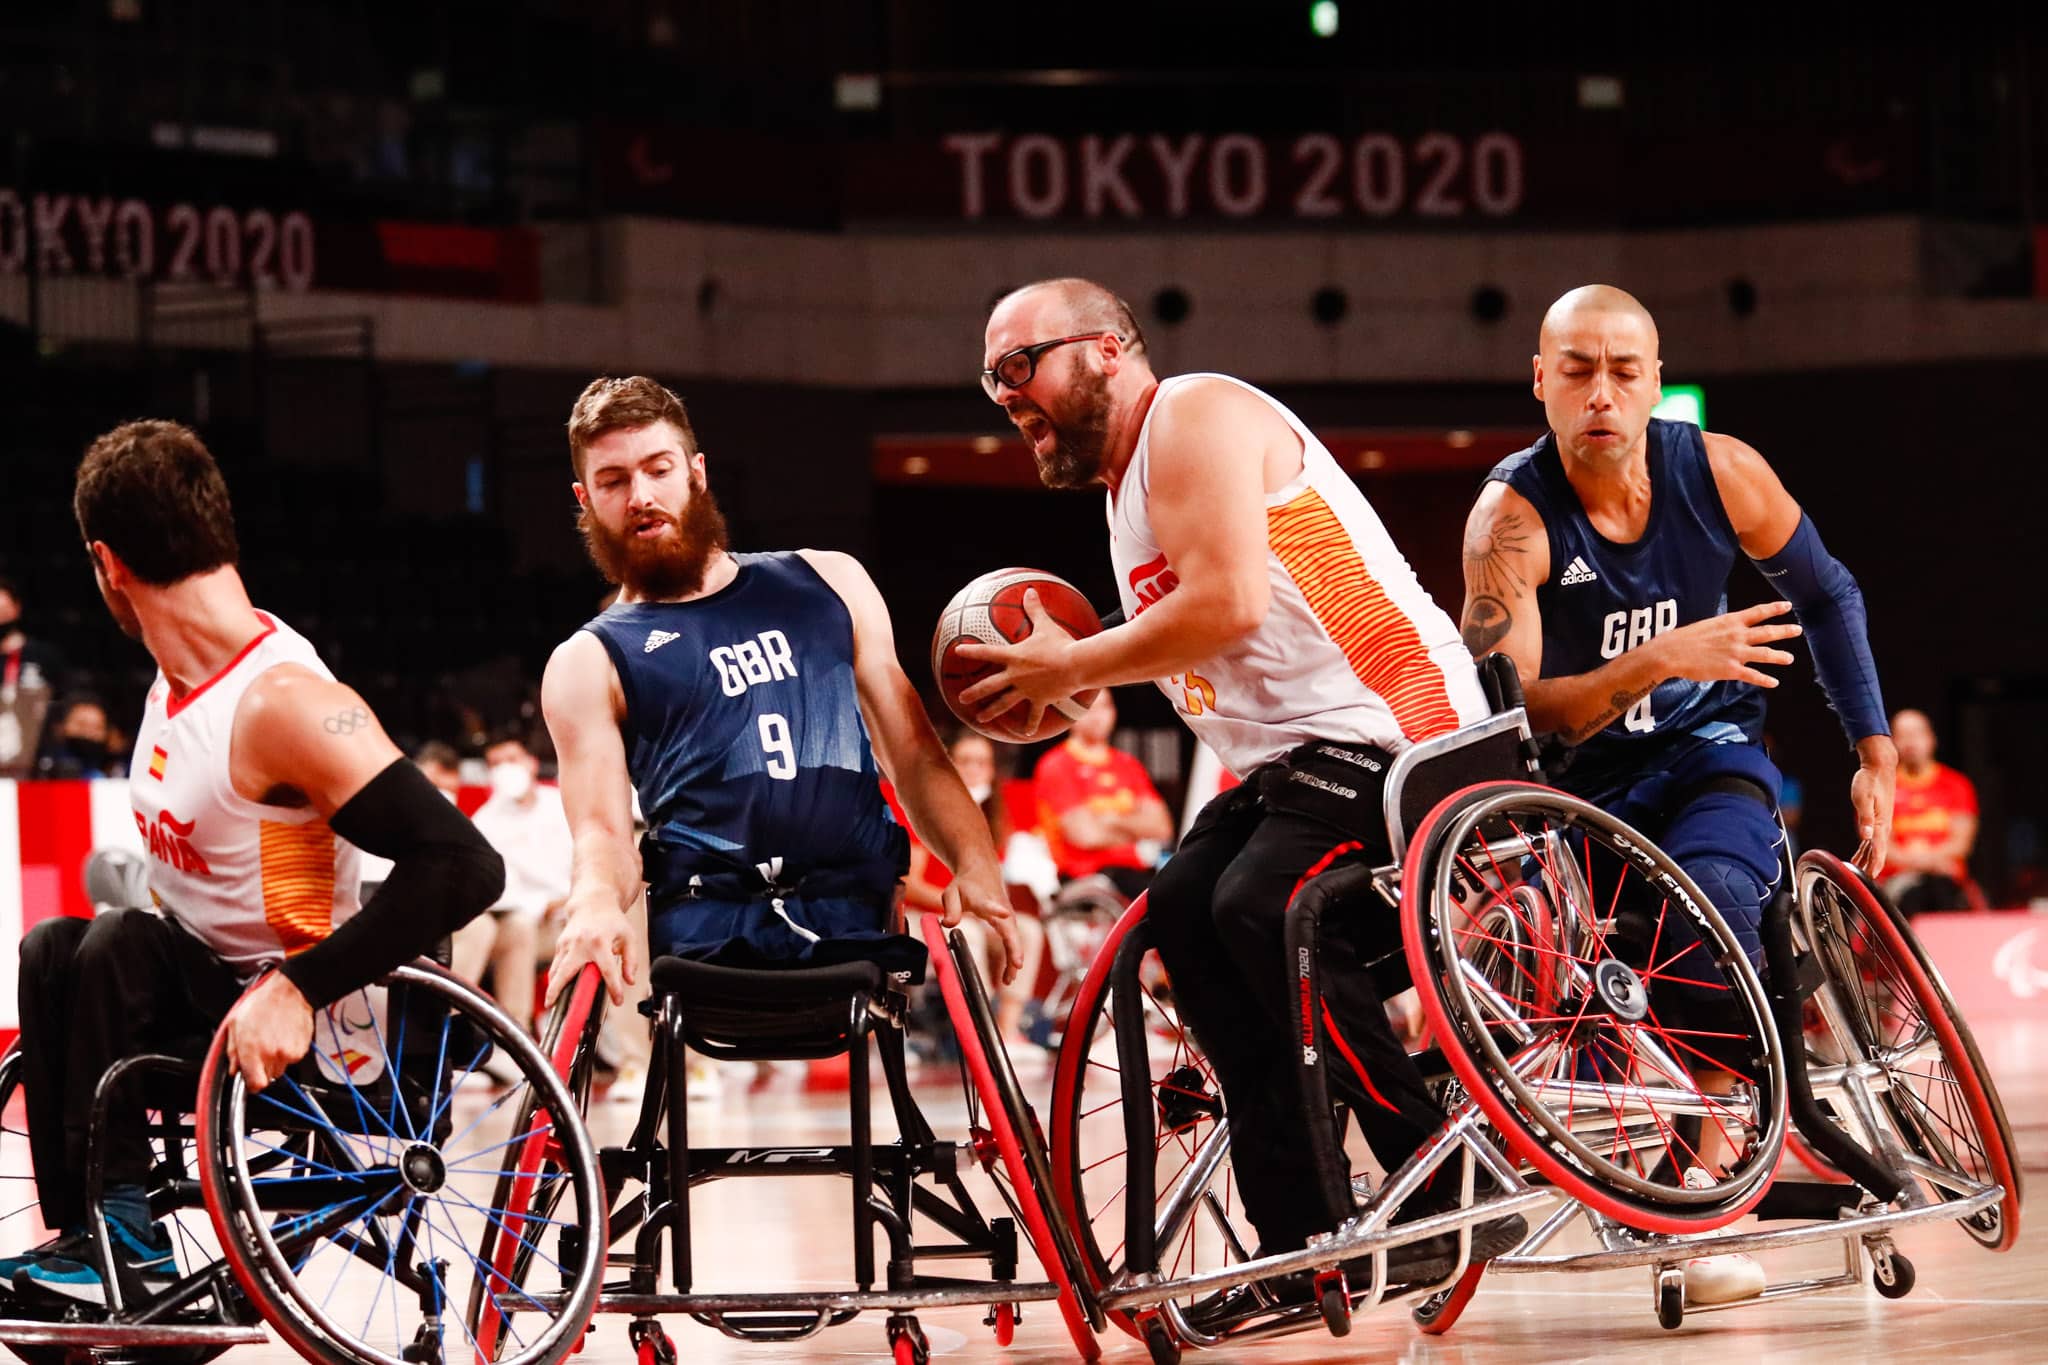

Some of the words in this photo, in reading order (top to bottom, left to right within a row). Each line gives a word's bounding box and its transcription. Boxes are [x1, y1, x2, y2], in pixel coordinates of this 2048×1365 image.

[943, 133, 1267, 217] TOKYO
[1295, 133, 1523, 216] 2020
[166, 203, 314, 289] 2020
[1561, 572, 1598, 586] adidas
[644, 631, 681, 653] adidas
[709, 629, 799, 697] GBR
[1624, 692, 1656, 733] 4
[758, 713, 797, 781] 9
[1298, 946, 1311, 978] 7020
